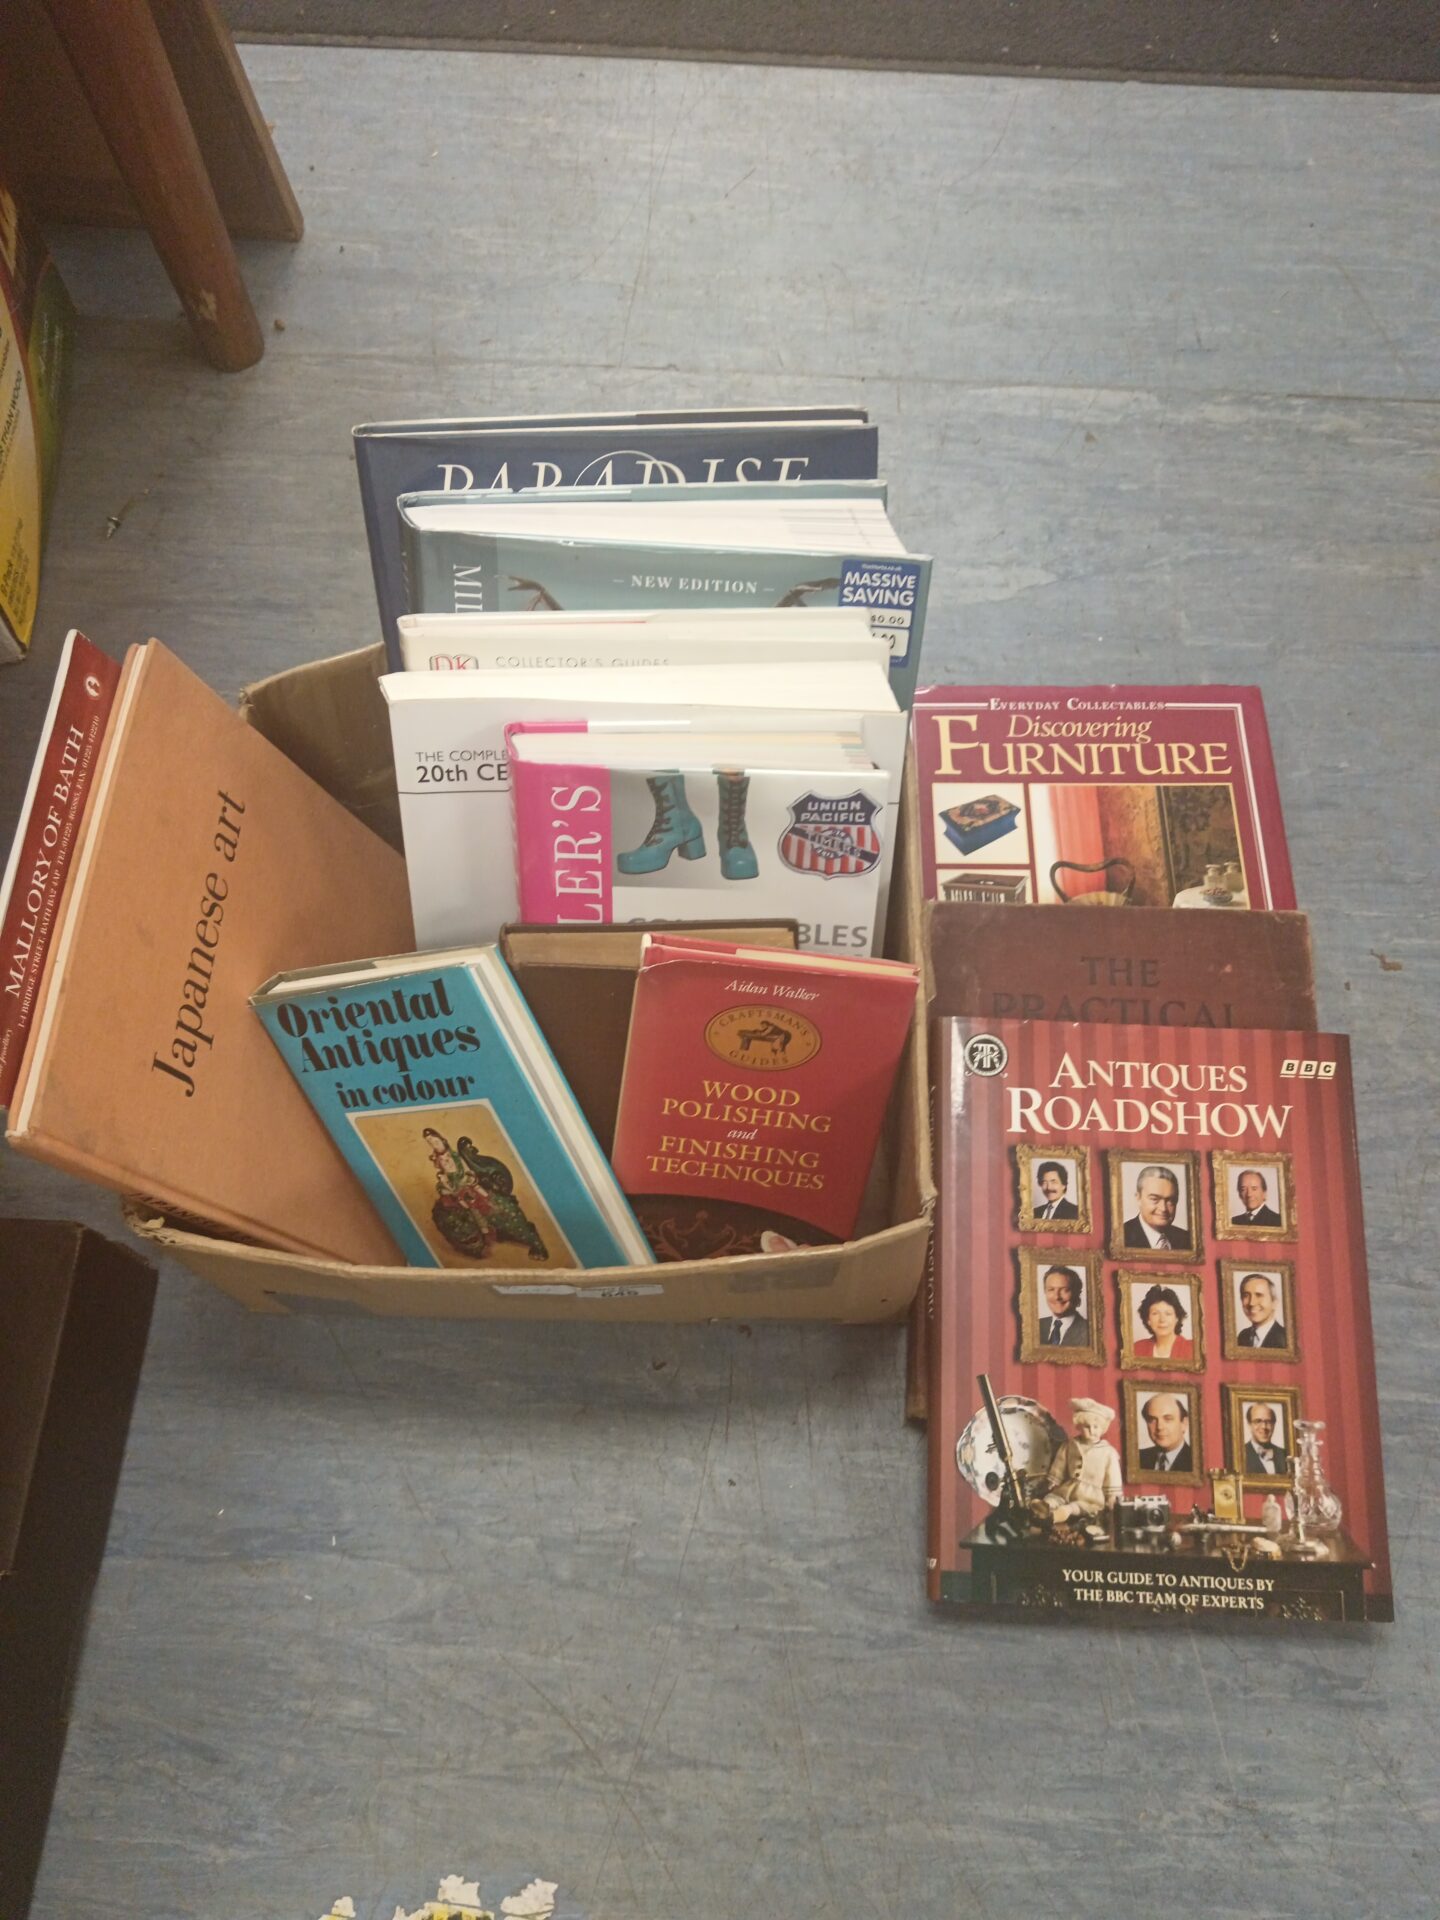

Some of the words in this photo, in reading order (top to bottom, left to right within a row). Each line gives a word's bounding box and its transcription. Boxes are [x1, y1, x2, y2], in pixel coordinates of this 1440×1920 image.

[631, 574, 673, 589] NEW
[679, 578, 758, 594] EDITION
[843, 571, 917, 590] MASSIVE
[842, 586, 915, 606] SAVING
[989, 697, 1060, 711] EVERYDAY
[1066, 697, 1165, 711] COLLECTABLES
[1007, 714, 1152, 744] Discovering
[415, 751, 444, 762] THE
[931, 713, 1233, 776] FURNITURE
[416, 764, 468, 783] 20th
[800, 812, 866, 822] PACIFIC
[807, 801, 861, 811] UNION
[4, 847, 52, 999] MALLORY
[43, 805, 63, 848] OF
[53, 723, 85, 804] BATH
[151, 872, 229, 1098] Japanese
[214, 789, 246, 863] art
[1080, 956, 1161, 988] THE
[22, 977, 36, 1016] BRIDGE
[725, 979, 769, 995] Aidan
[772, 985, 820, 1001] Walker
[277, 978, 454, 1038] Oriental
[302, 1025, 481, 1073] Antiques
[1049, 1052, 1249, 1097] ANTIQUES
[335, 1081, 370, 1109] in
[373, 1074, 475, 1105] colour
[702, 1080, 801, 1107] WOOD
[662, 1097, 832, 1133] POLISHING
[1006, 1086, 1294, 1139] ROADSHOW
[727, 1128, 759, 1140] and
[659, 1135, 820, 1169] FINISHING
[646, 1155, 825, 1190] TECHNIQUES
[1062, 1568, 1105, 1583] YOUR
[1107, 1571, 1153, 1586] GUIDE
[1156, 1573, 1177, 1587] TO
[1179, 1575, 1254, 1591] ANTIQUES
[1256, 1579, 1275, 1592] BY
[1074, 1587, 1103, 1602] THE
[1106, 1589, 1134, 1603] BBC
[1136, 1591, 1176, 1606] TEAM
[1179, 1593, 1200, 1607] OF
[1202, 1595, 1265, 1610] EXPERTS
